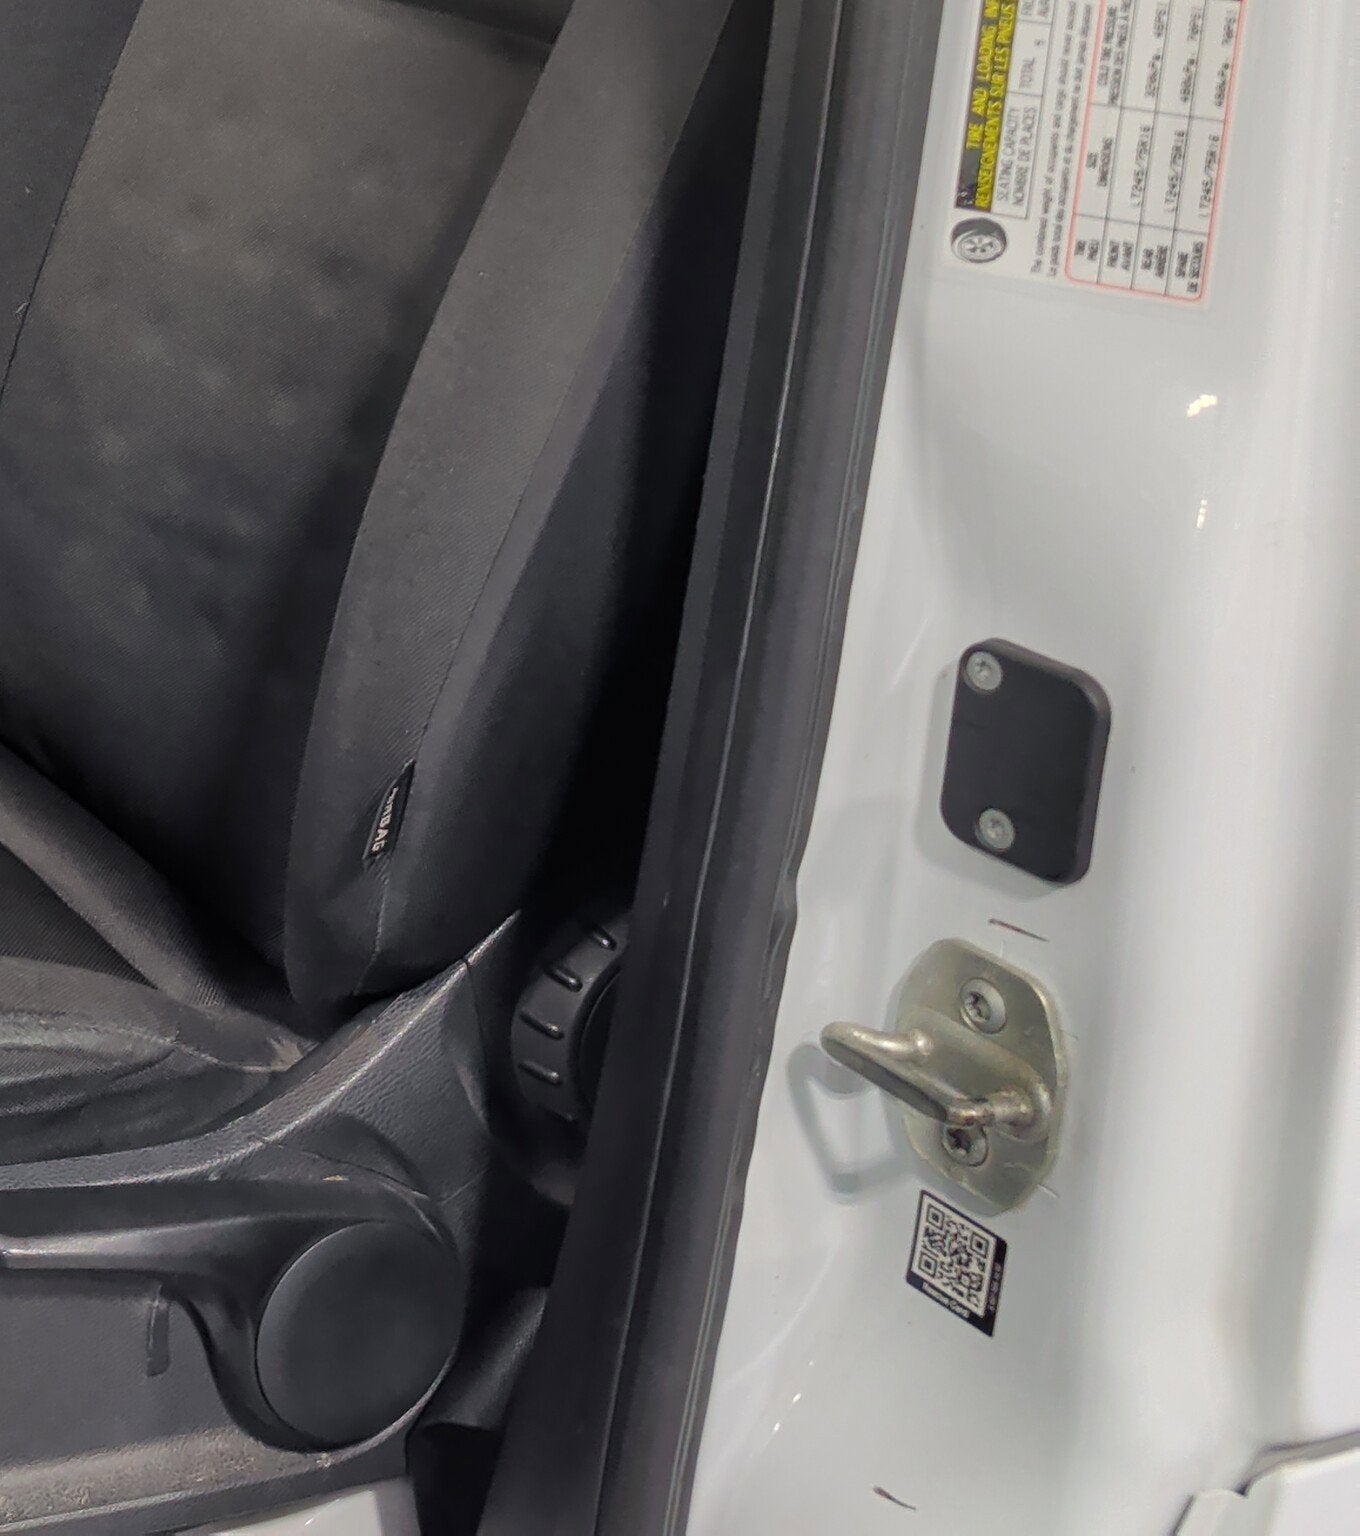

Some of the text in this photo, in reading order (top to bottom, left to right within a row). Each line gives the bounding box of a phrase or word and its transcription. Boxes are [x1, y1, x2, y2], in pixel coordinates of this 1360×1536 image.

[994, 2, 1015, 44] PNEUS
[974, 23, 996, 81] LOADING
[991, 46, 1010, 70] LES
[988, 72, 1006, 97] SUR
[1018, 56, 1034, 90] TOTAL
[969, 85, 988, 115] AND
[965, 122, 983, 150] TIRE
[974, 99, 1003, 207] RENSEIGNEMENTS
[996, 106, 1020, 202] SEATING CAPACITY
[1011, 106, 1035, 206] NOMBRE DE PLACES
